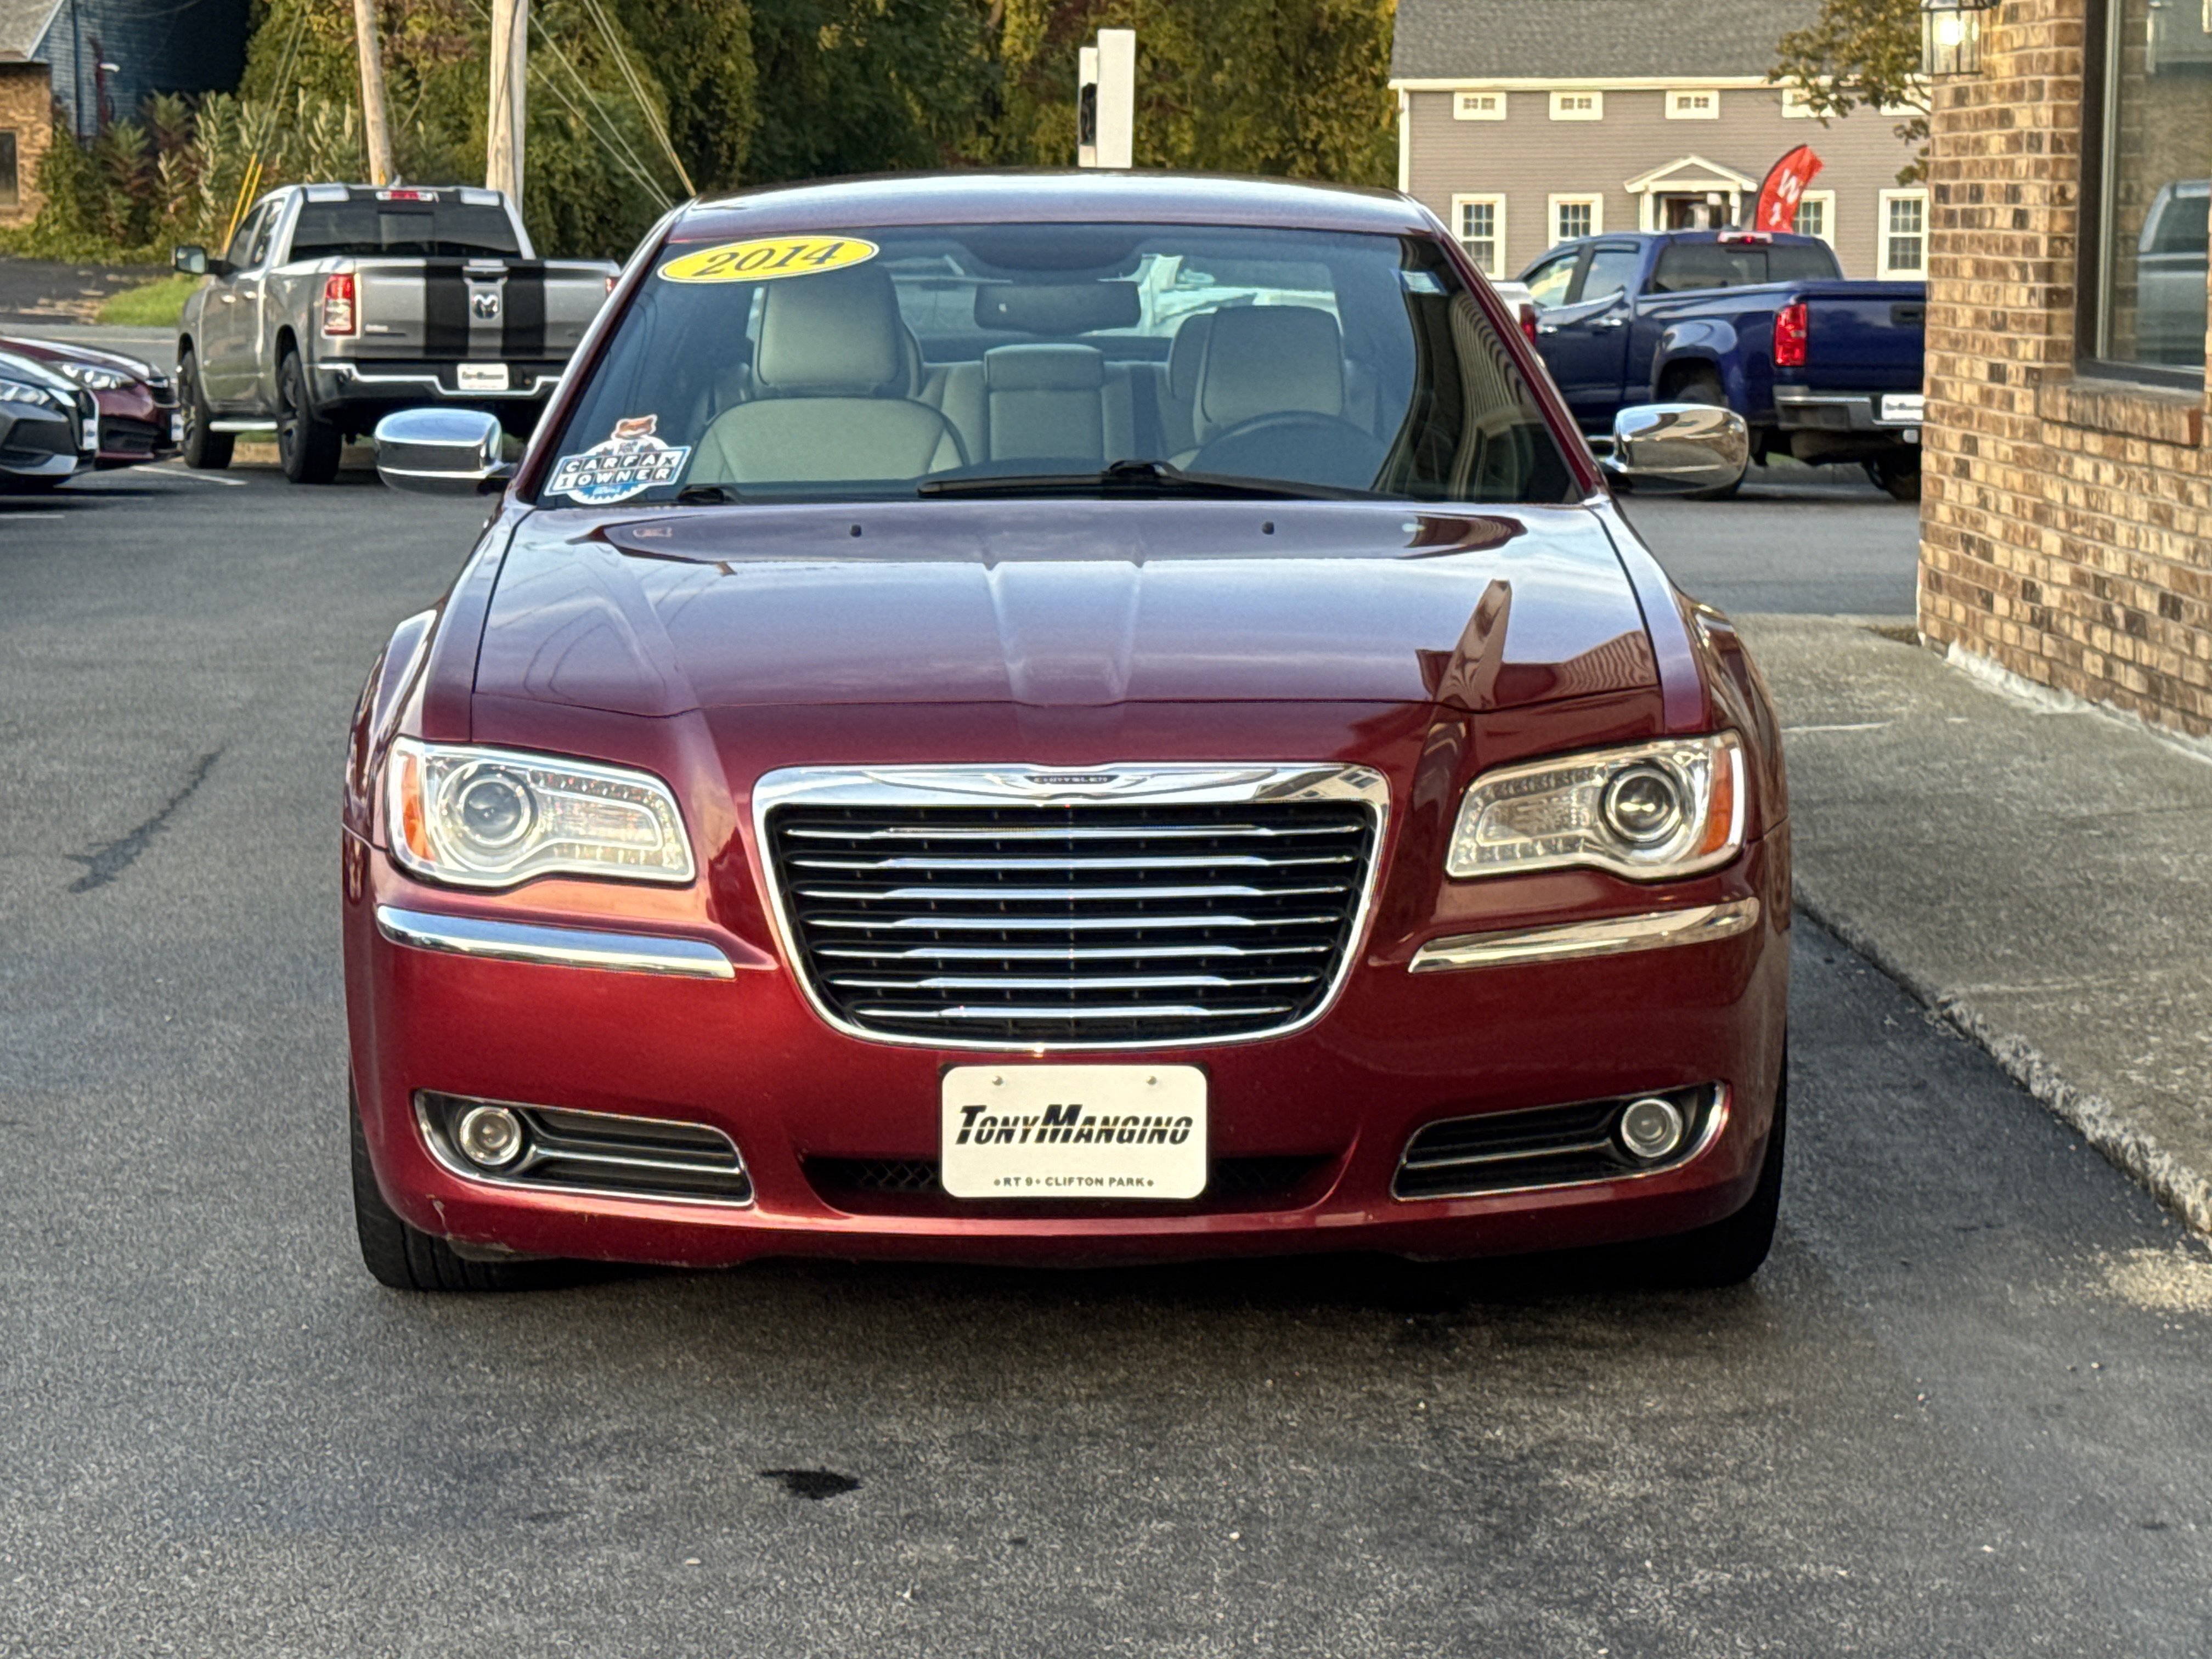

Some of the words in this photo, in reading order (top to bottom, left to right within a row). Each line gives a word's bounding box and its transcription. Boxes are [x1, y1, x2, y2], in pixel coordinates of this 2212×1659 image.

[691, 241, 845, 277] 2014
[565, 454, 676, 472] CARFAX
[560, 477, 568, 488] 1
[578, 467, 670, 486] OWNER
[1003, 1177, 1022, 1187] RT
[1045, 1176, 1104, 1187] CLIFTON
[1108, 1177, 1146, 1188] PARK
